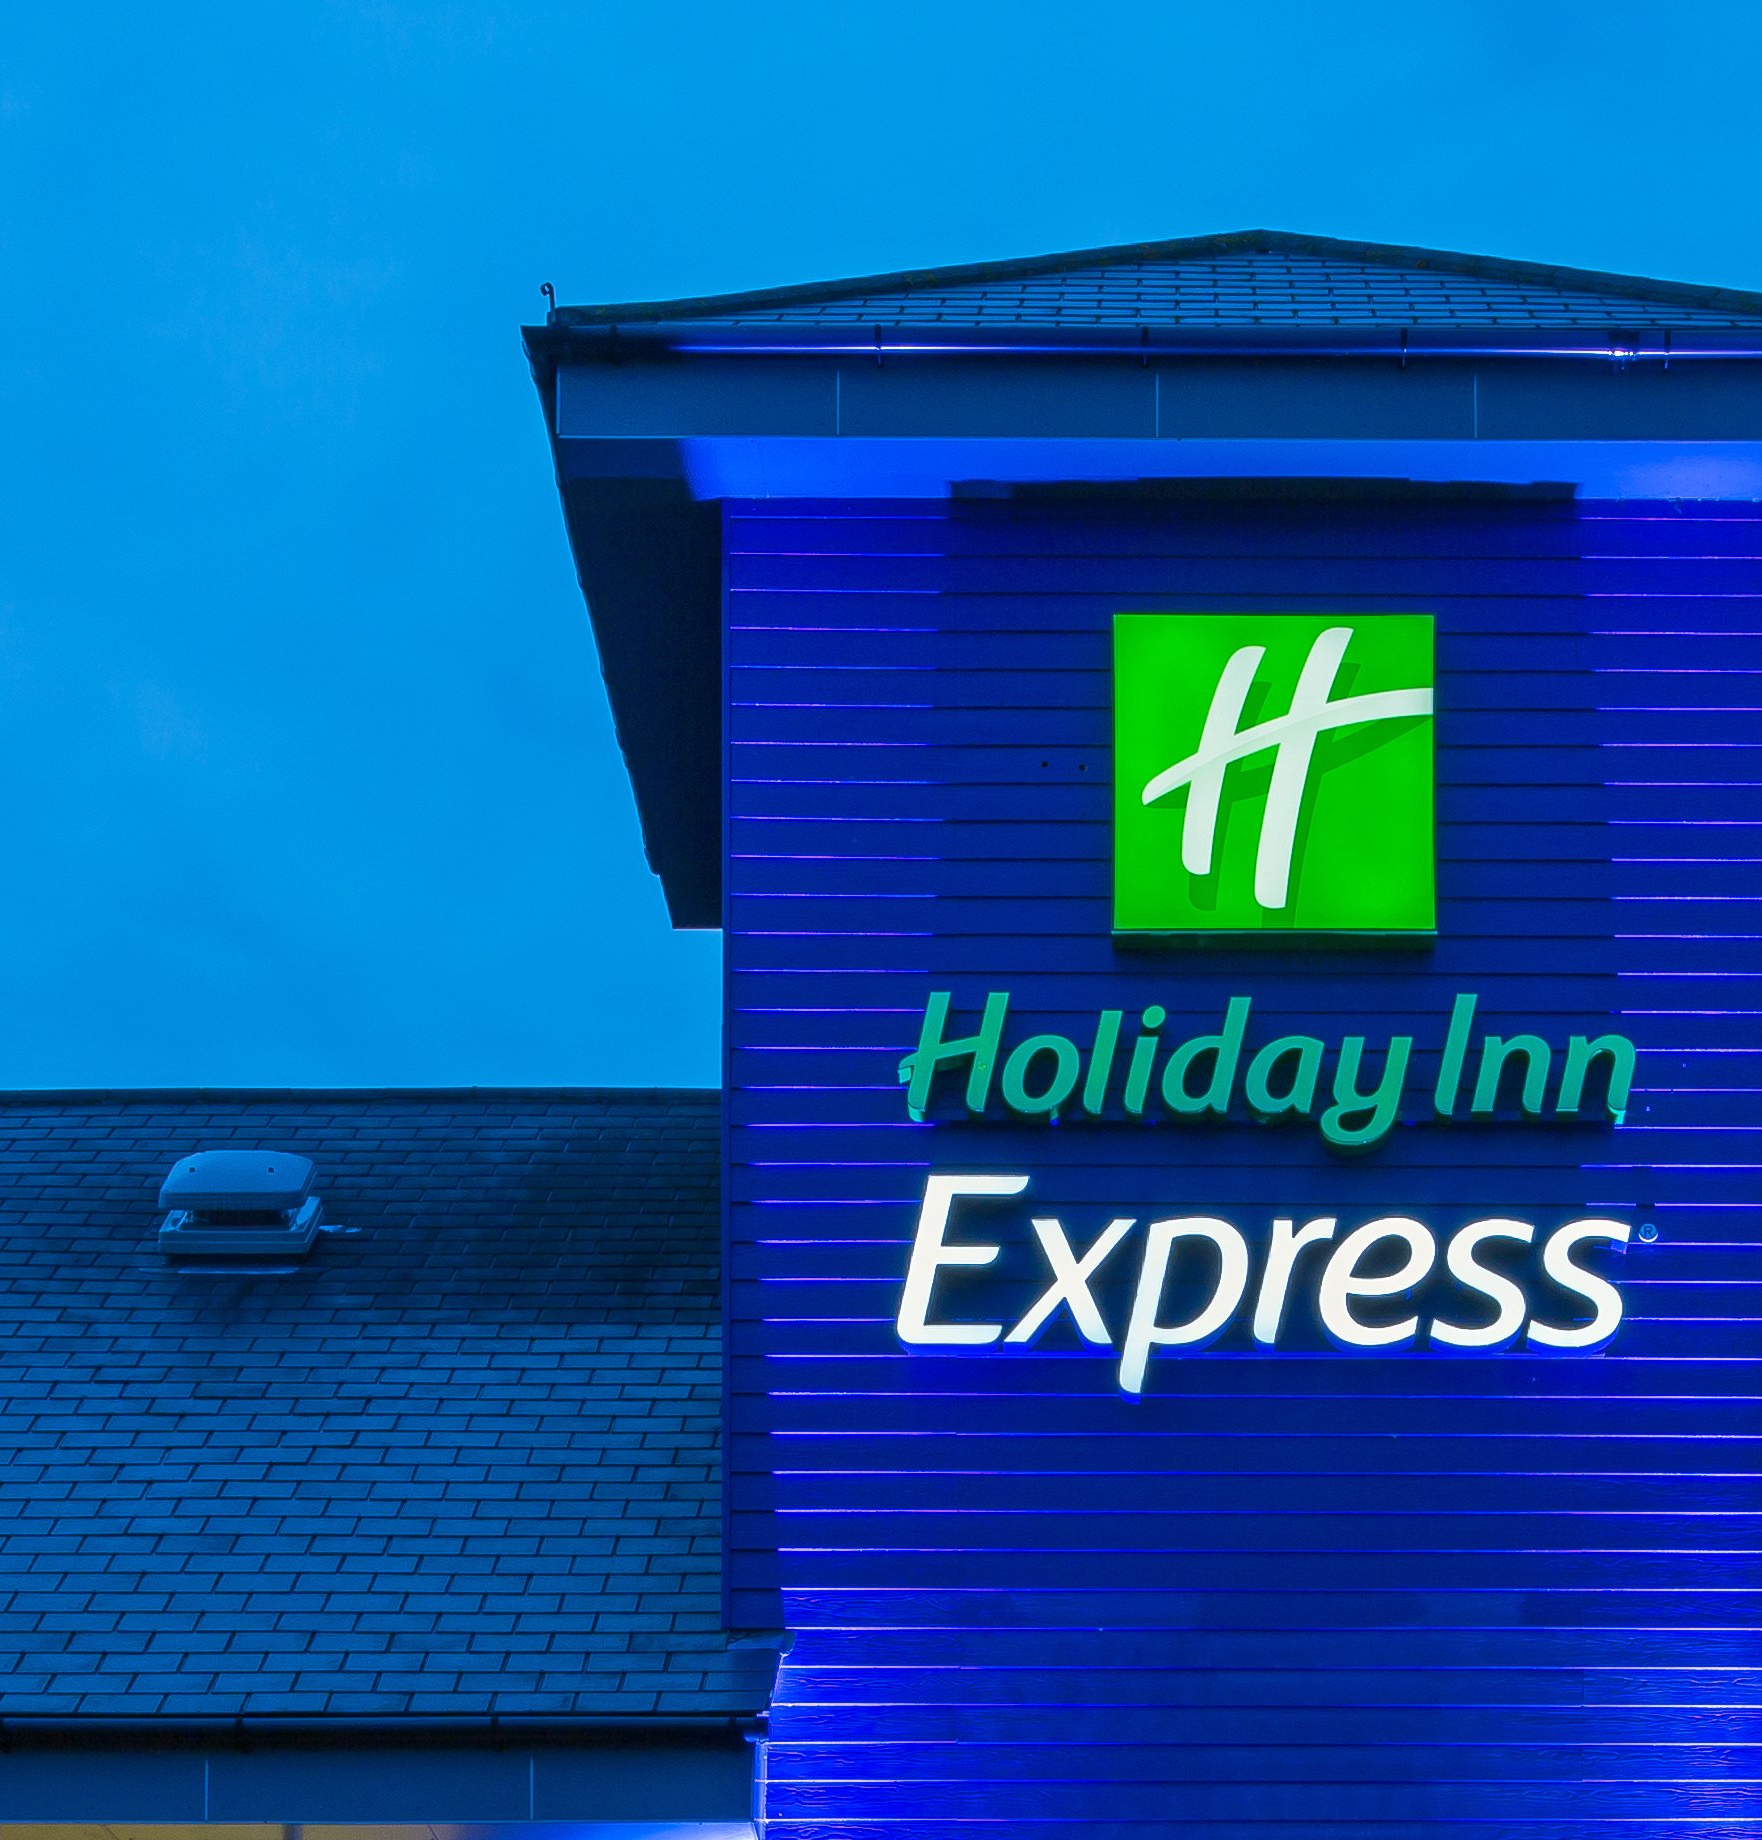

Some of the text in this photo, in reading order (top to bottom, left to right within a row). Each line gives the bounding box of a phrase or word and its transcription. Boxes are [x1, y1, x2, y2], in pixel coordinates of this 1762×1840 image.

[1142, 627, 1434, 909] H
[898, 992, 1636, 1146] Holiday Inn
[896, 1175, 1631, 1393] Express
